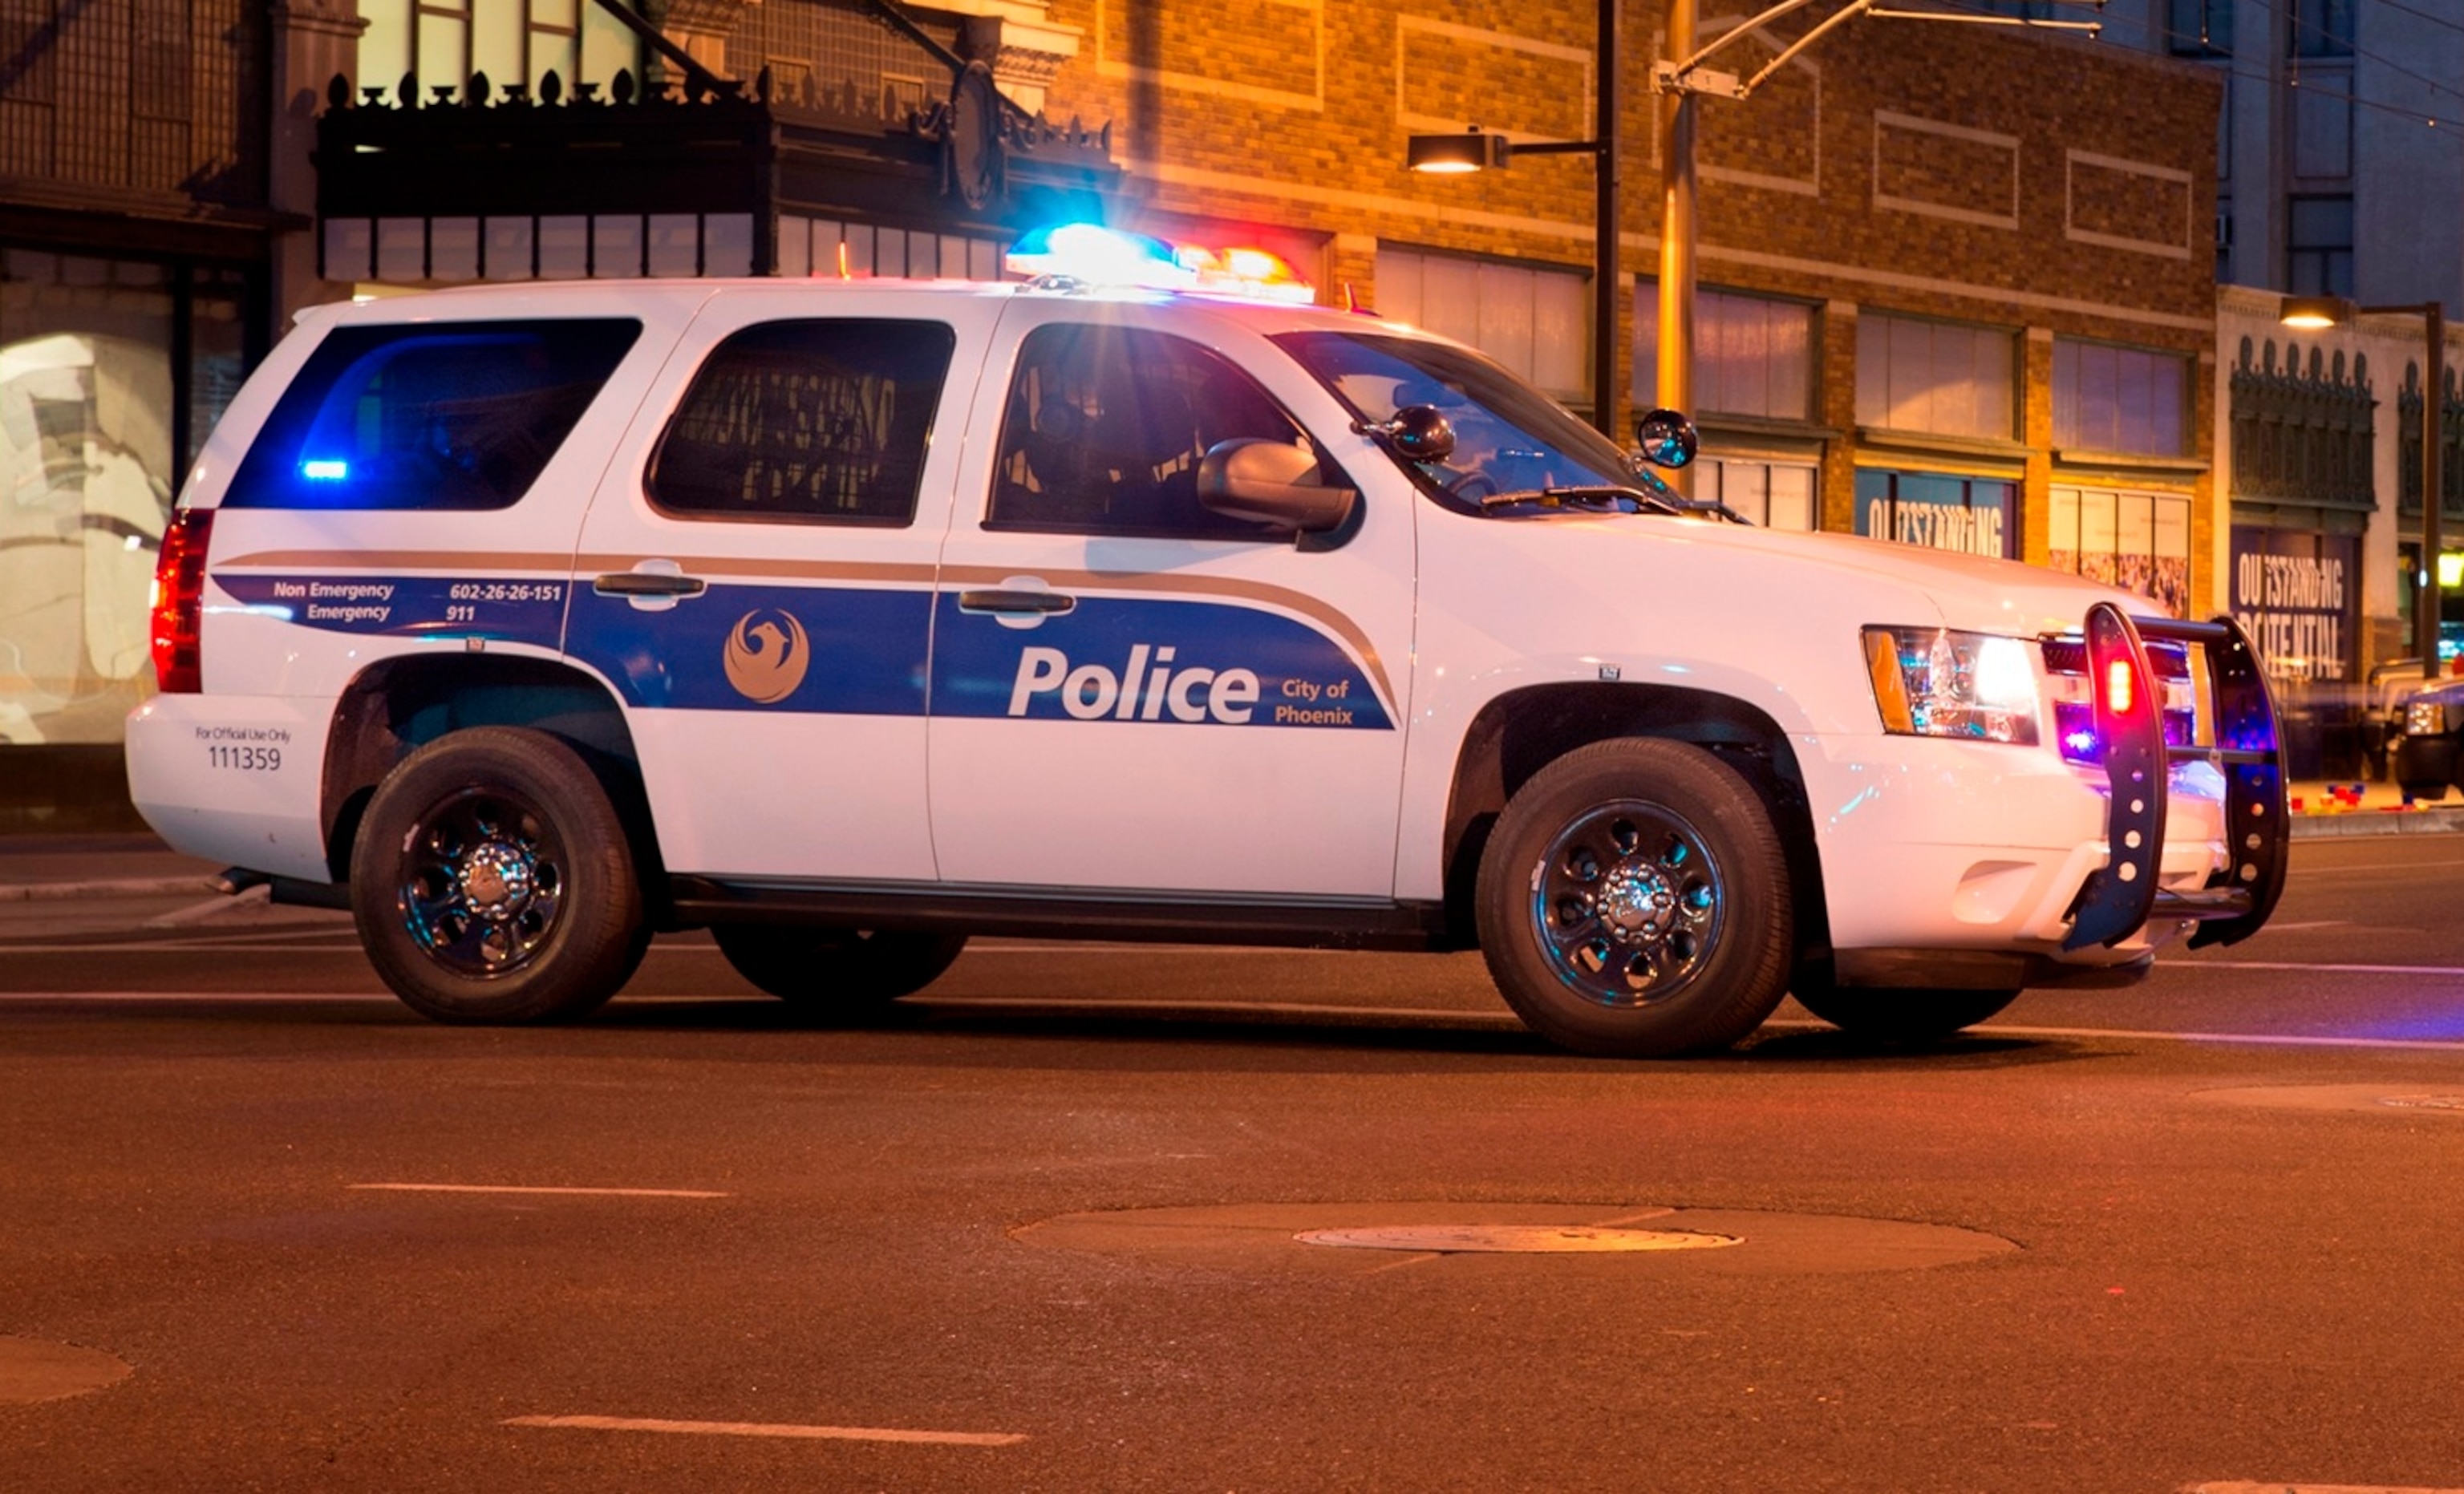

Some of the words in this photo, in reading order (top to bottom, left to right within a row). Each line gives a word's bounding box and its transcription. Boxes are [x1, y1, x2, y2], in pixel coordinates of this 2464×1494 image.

[274, 582, 306, 597] Non
[310, 582, 395, 601] Emergency
[449, 584, 561, 601] 602-26-26-151
[307, 604, 391, 621] Emergency
[446, 605, 476, 621] 911
[1007, 644, 1261, 724] Police
[1282, 678, 1322, 702] City
[1330, 680, 1349, 699] of
[1275, 706, 1353, 725] Phoenix
[196, 727, 210, 739] For
[213, 727, 247, 740] Official
[249, 729, 267, 741] Use
[268, 729, 291, 745] Only
[209, 746, 282, 771] 111359
